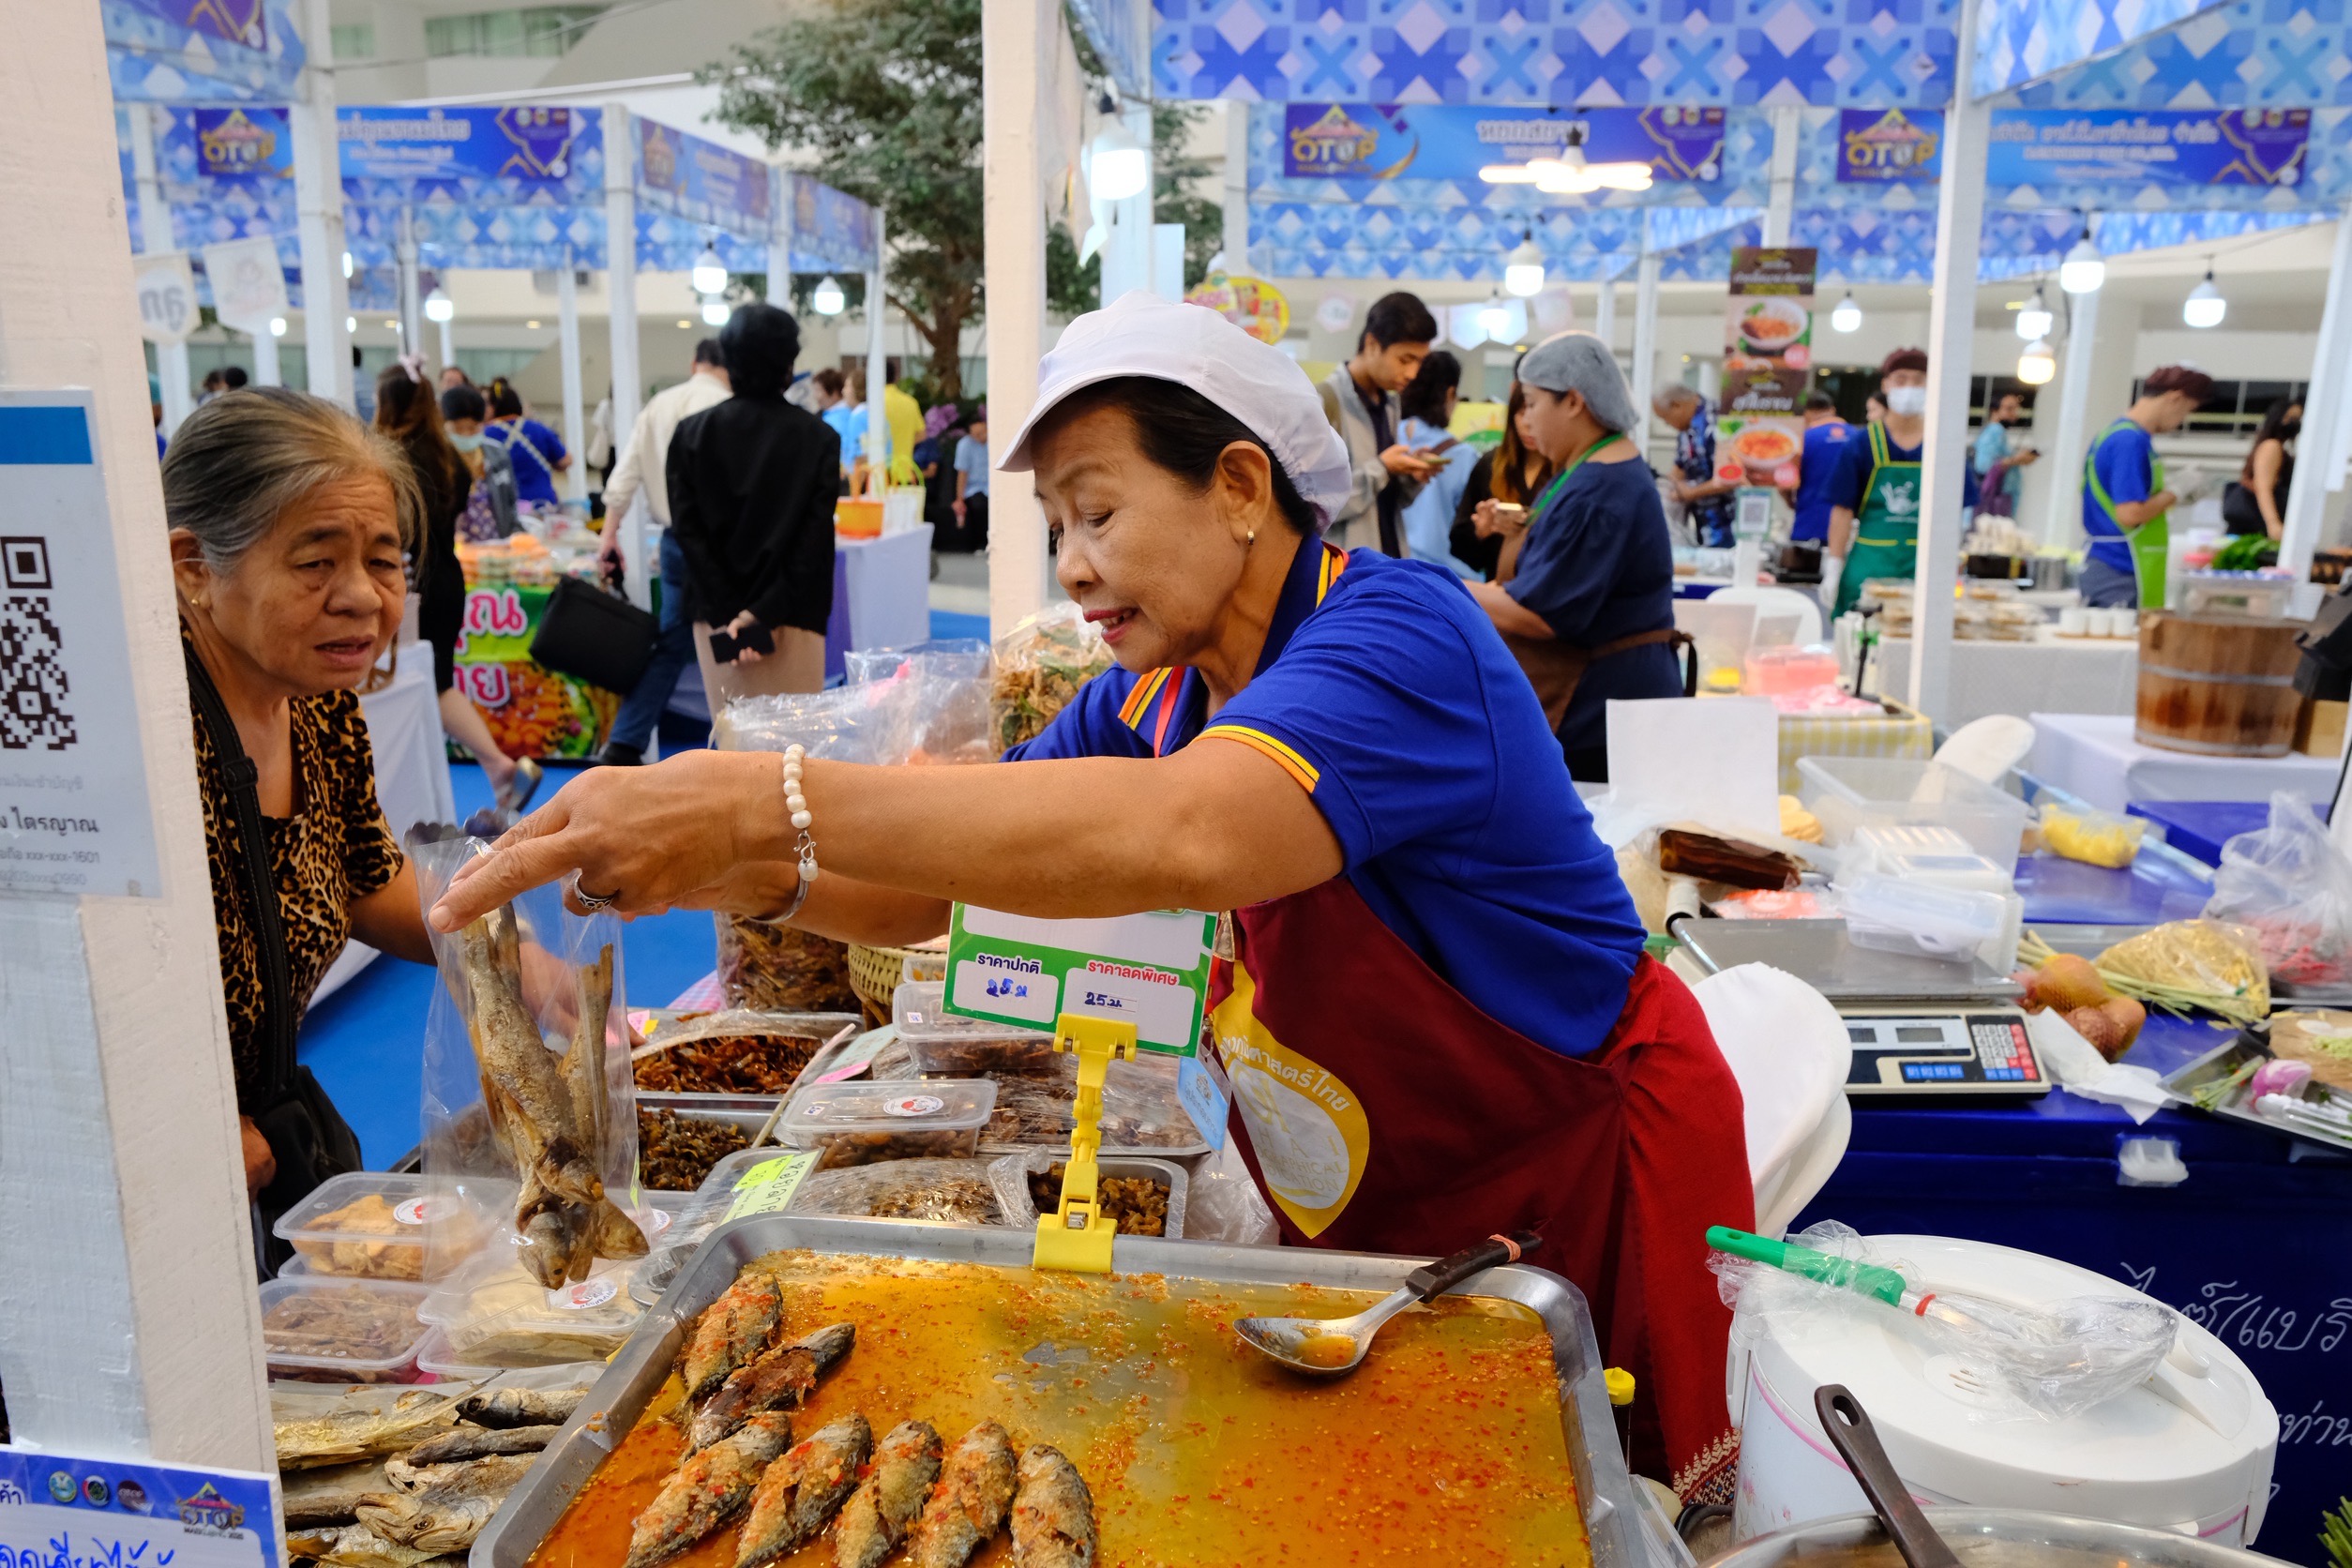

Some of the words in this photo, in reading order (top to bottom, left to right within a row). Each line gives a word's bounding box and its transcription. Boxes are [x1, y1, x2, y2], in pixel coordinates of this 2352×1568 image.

[1292, 138, 1377, 163] OTOP
[1847, 142, 1936, 168] OTOP
[977, 955, 1040, 974] ราคาปกติ
[1088, 961, 1177, 986] ราคาลดพิเศษ
[179, 1505, 245, 1530] OTOP
